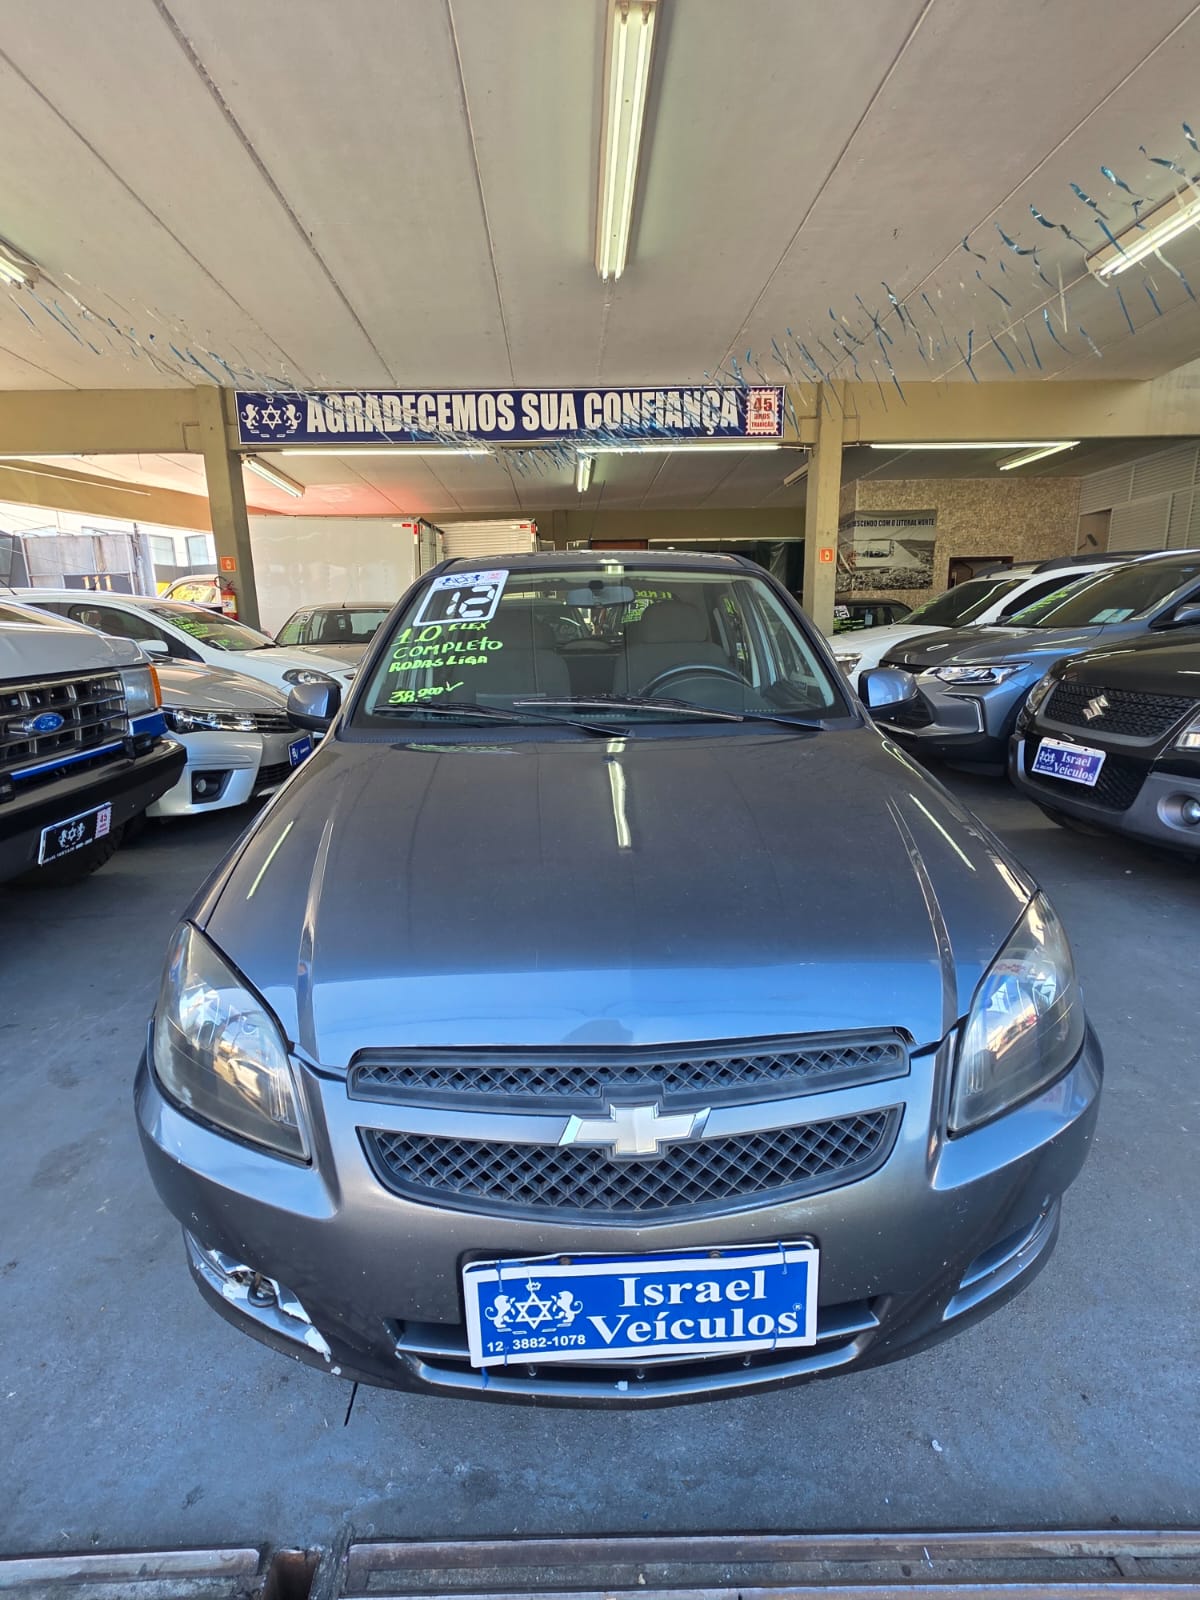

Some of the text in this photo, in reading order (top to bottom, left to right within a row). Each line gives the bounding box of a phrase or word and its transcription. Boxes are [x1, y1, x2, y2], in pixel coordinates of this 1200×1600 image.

[306, 390, 739, 435] AGRADECEMOS SUA CONFIANÇA
[753, 398, 773, 411] 45
[446, 585, 496, 618] 12
[388, 658, 444, 673] RODAS
[1061, 751, 1092, 767] Israel
[1053, 761, 1094, 781] Veículos
[618, 1270, 767, 1308] Israel
[587, 1308, 799, 1345] Veículos
[486, 1334, 587, 1353] 12 3882-1078
